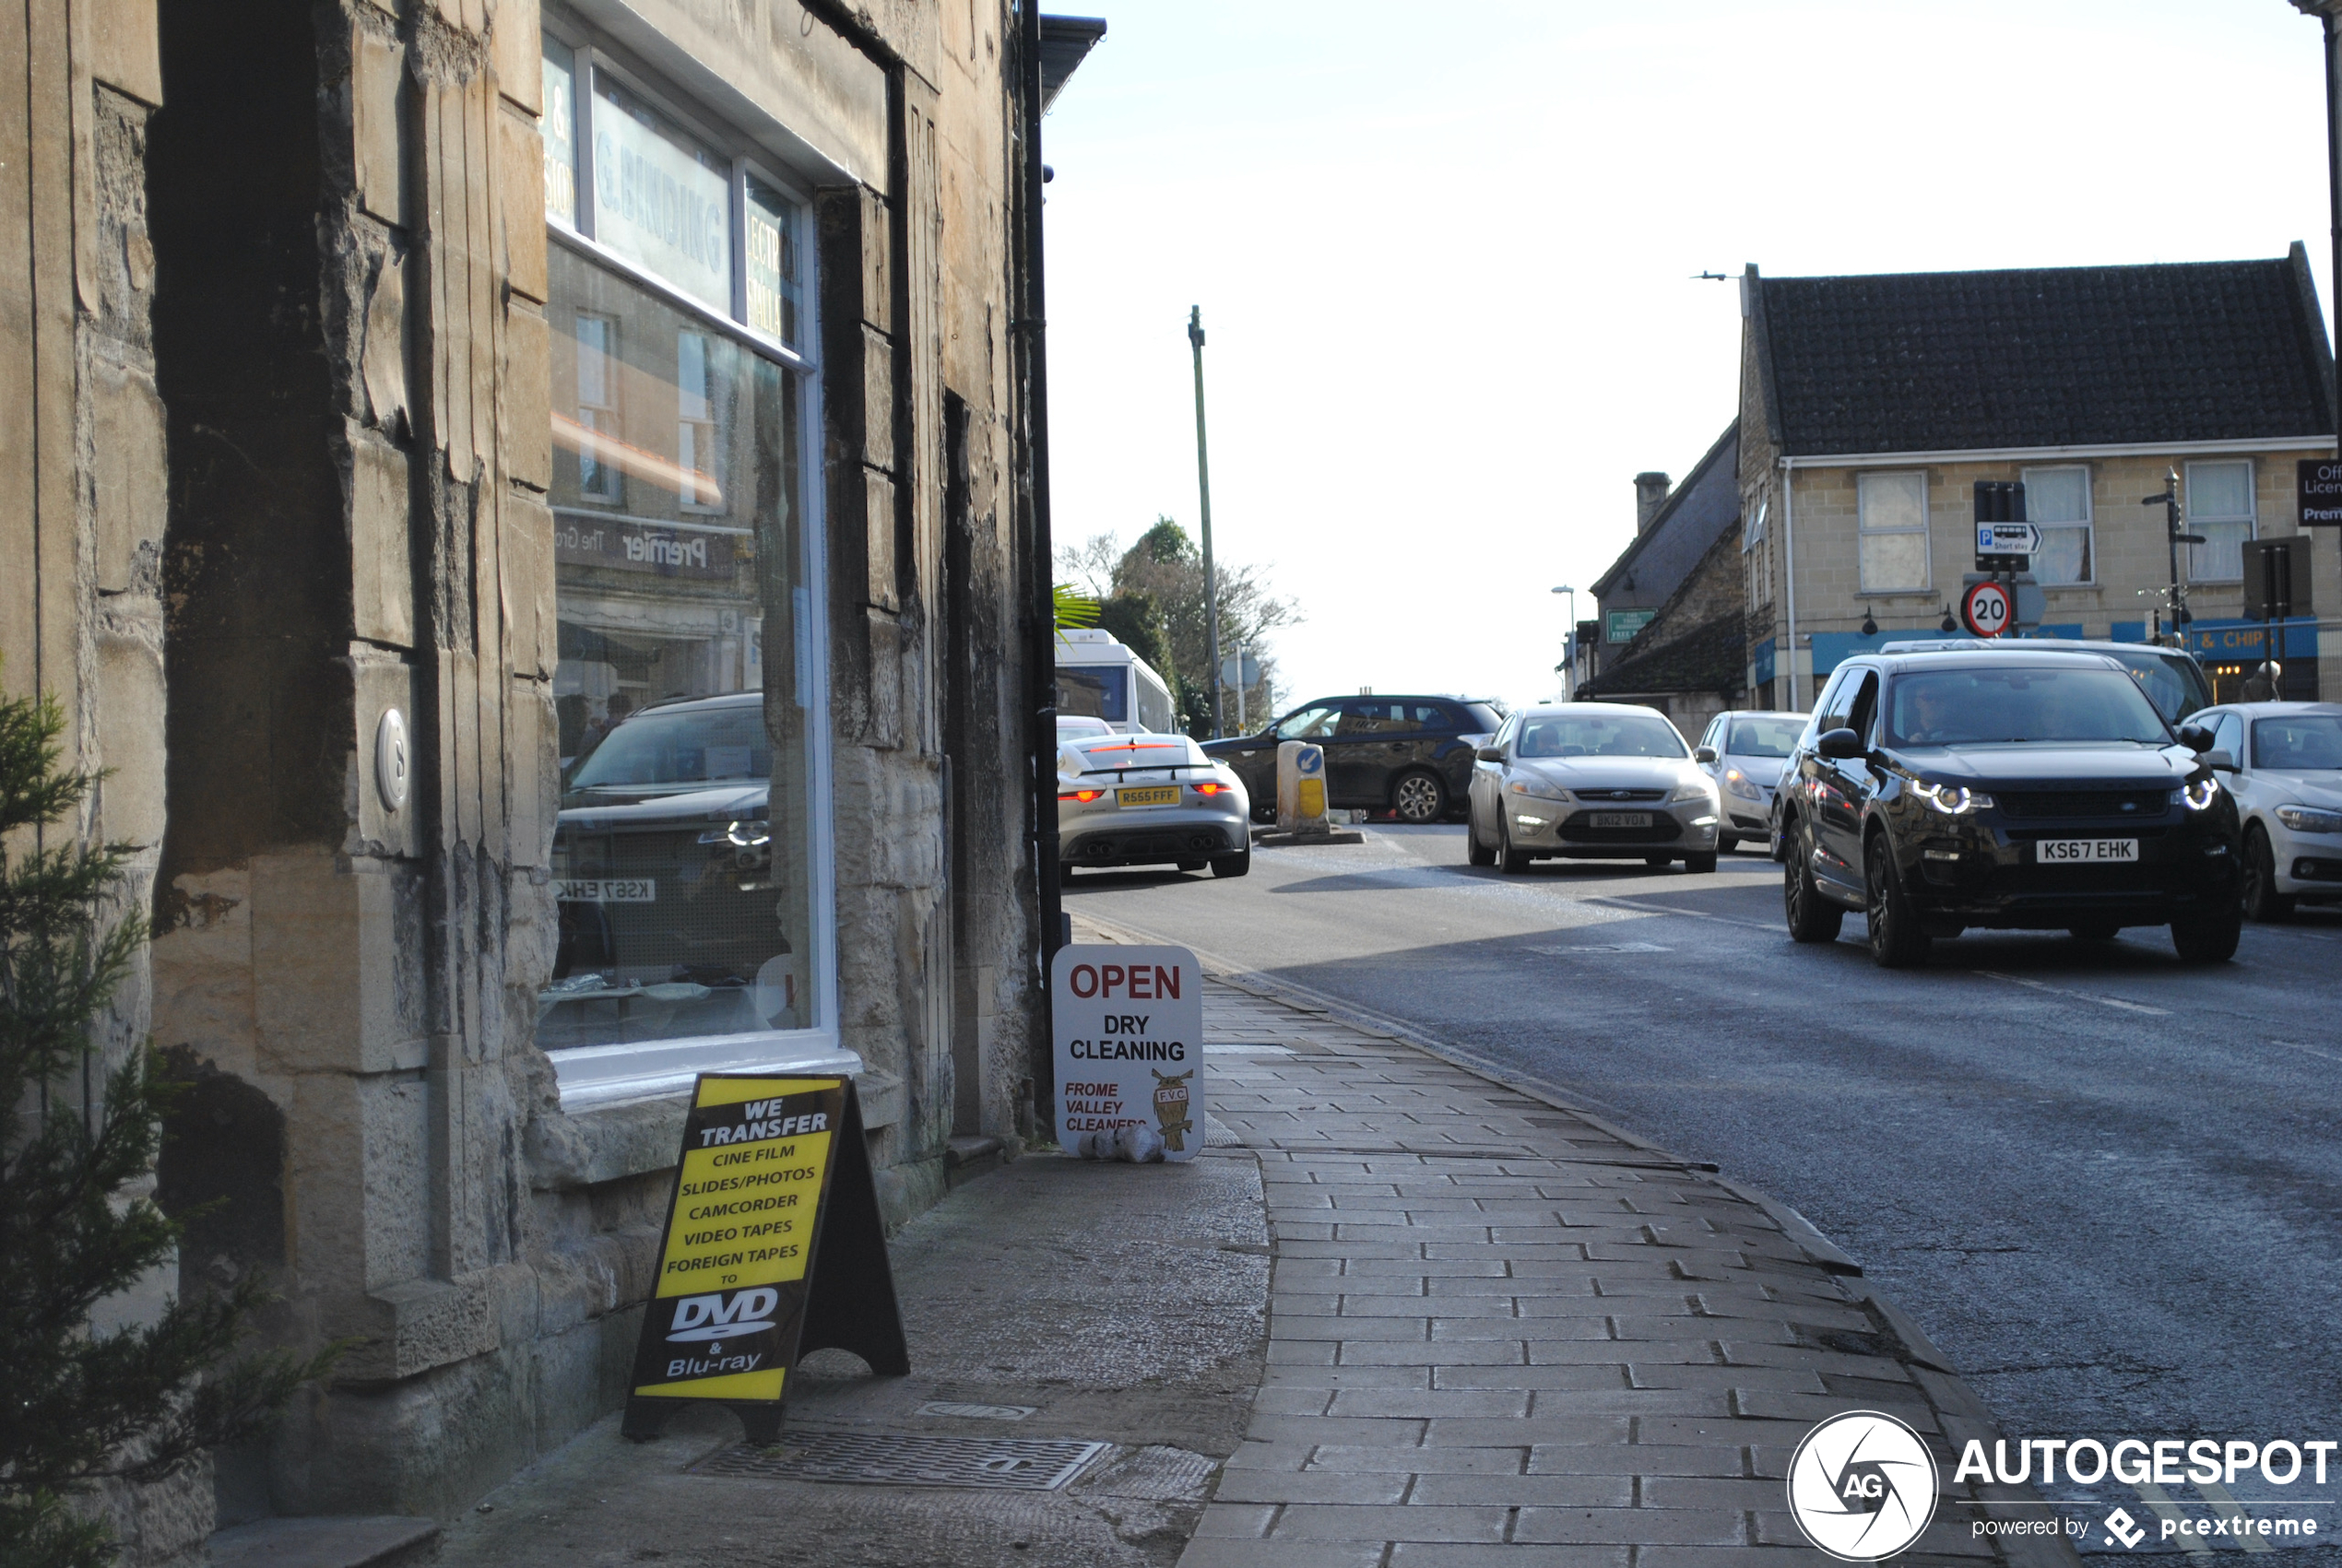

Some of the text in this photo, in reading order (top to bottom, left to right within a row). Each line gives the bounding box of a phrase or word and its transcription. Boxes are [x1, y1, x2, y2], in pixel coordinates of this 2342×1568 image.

[1975, 599, 2005, 620] 20
[1153, 790, 1174, 801] FFF
[2044, 841, 2132, 859] KS67 EHK
[1070, 964, 1180, 999] OPEN
[1105, 1015, 1150, 1034] DRY
[1070, 1040, 1185, 1061] CLEANING
[1065, 1082, 1118, 1097] FROME
[744, 1098, 783, 1121] WE
[1066, 1101, 1124, 1114] VALLEY
[700, 1113, 828, 1148] TRANSFER
[713, 1145, 795, 1168] CINE FILM
[681, 1166, 815, 1197] SLIDES/PHOTOS
[689, 1194, 798, 1220] CAMCORDER
[684, 1220, 793, 1246] VIDEO TAPES
[667, 1244, 799, 1274] FOREIGN TAPES
[721, 1274, 738, 1284] TO
[670, 1288, 778, 1331] DVD
[709, 1343, 722, 1355] &
[667, 1352, 762, 1378] Blu-ray
